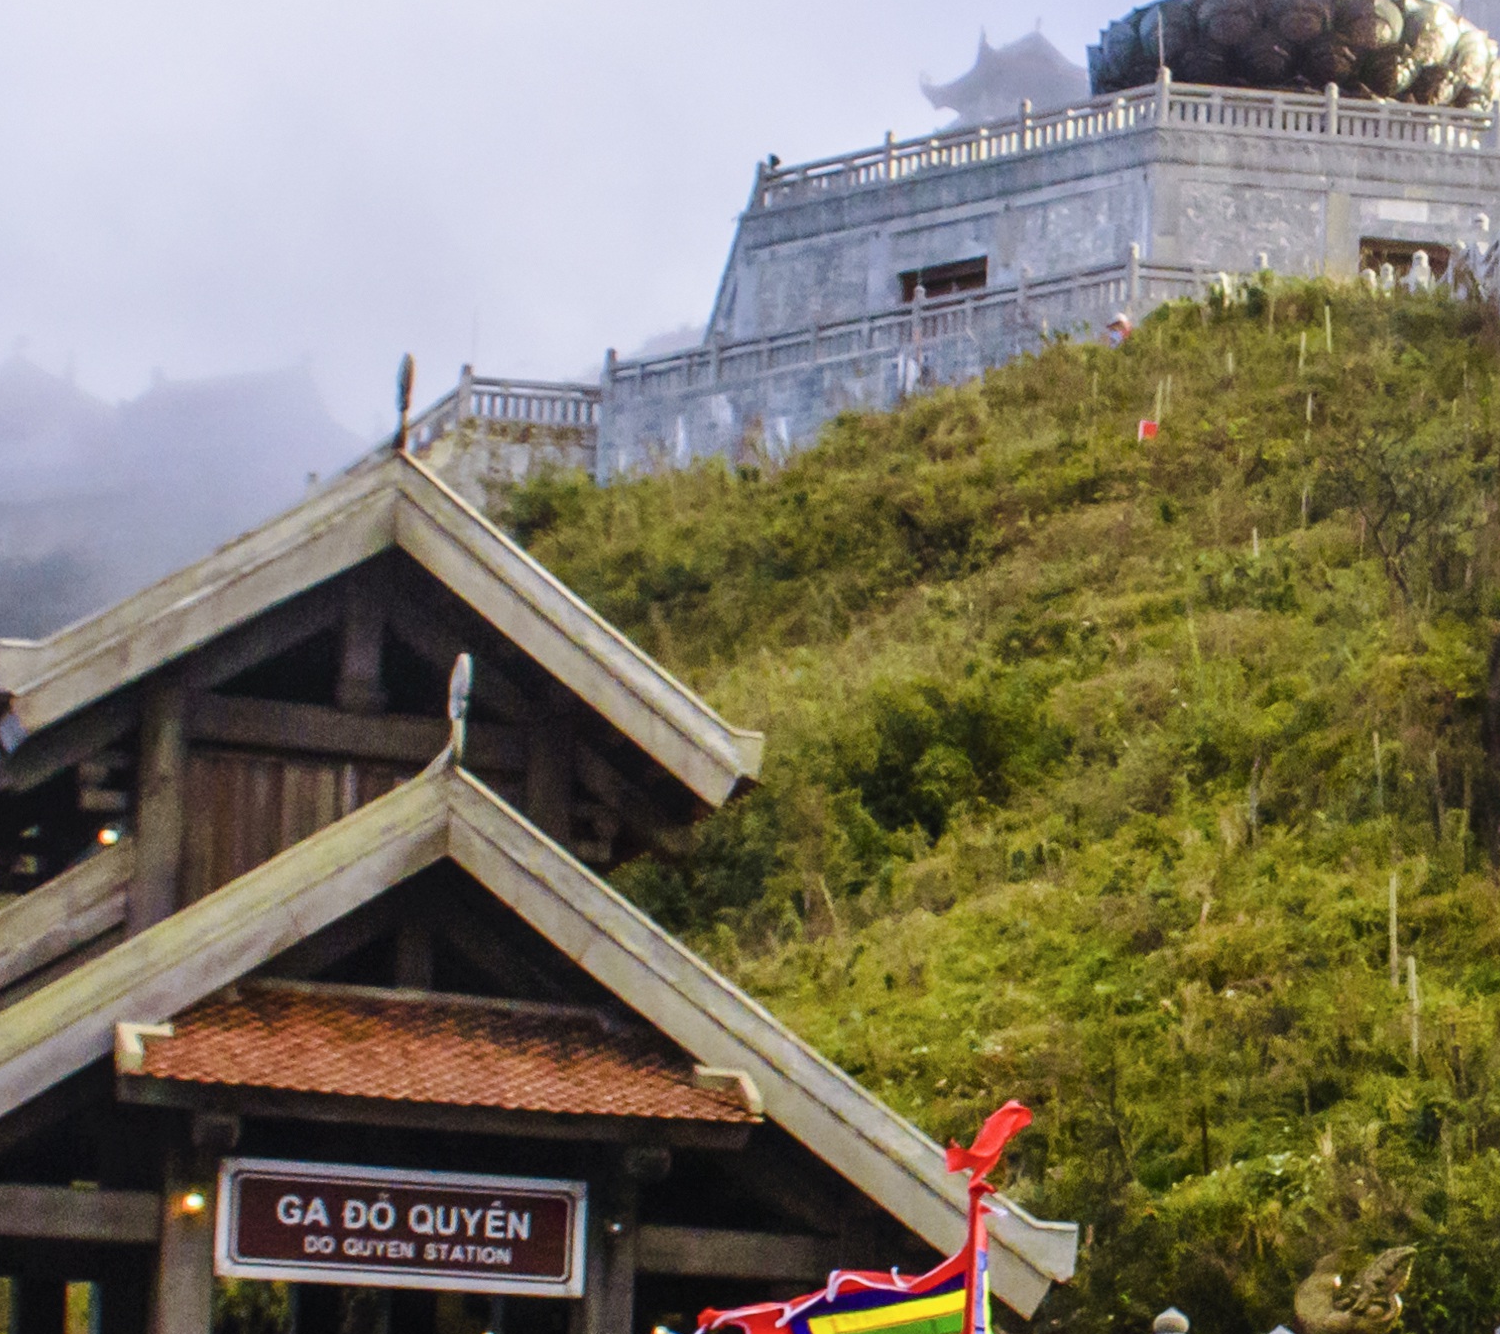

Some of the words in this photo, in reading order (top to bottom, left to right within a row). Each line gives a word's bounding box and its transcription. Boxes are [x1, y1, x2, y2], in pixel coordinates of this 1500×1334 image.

[276, 1193, 330, 1228] GA
[303, 1234, 337, 1255] DO
[342, 1236, 416, 1260] QUYEN
[423, 1241, 513, 1266] STATION
